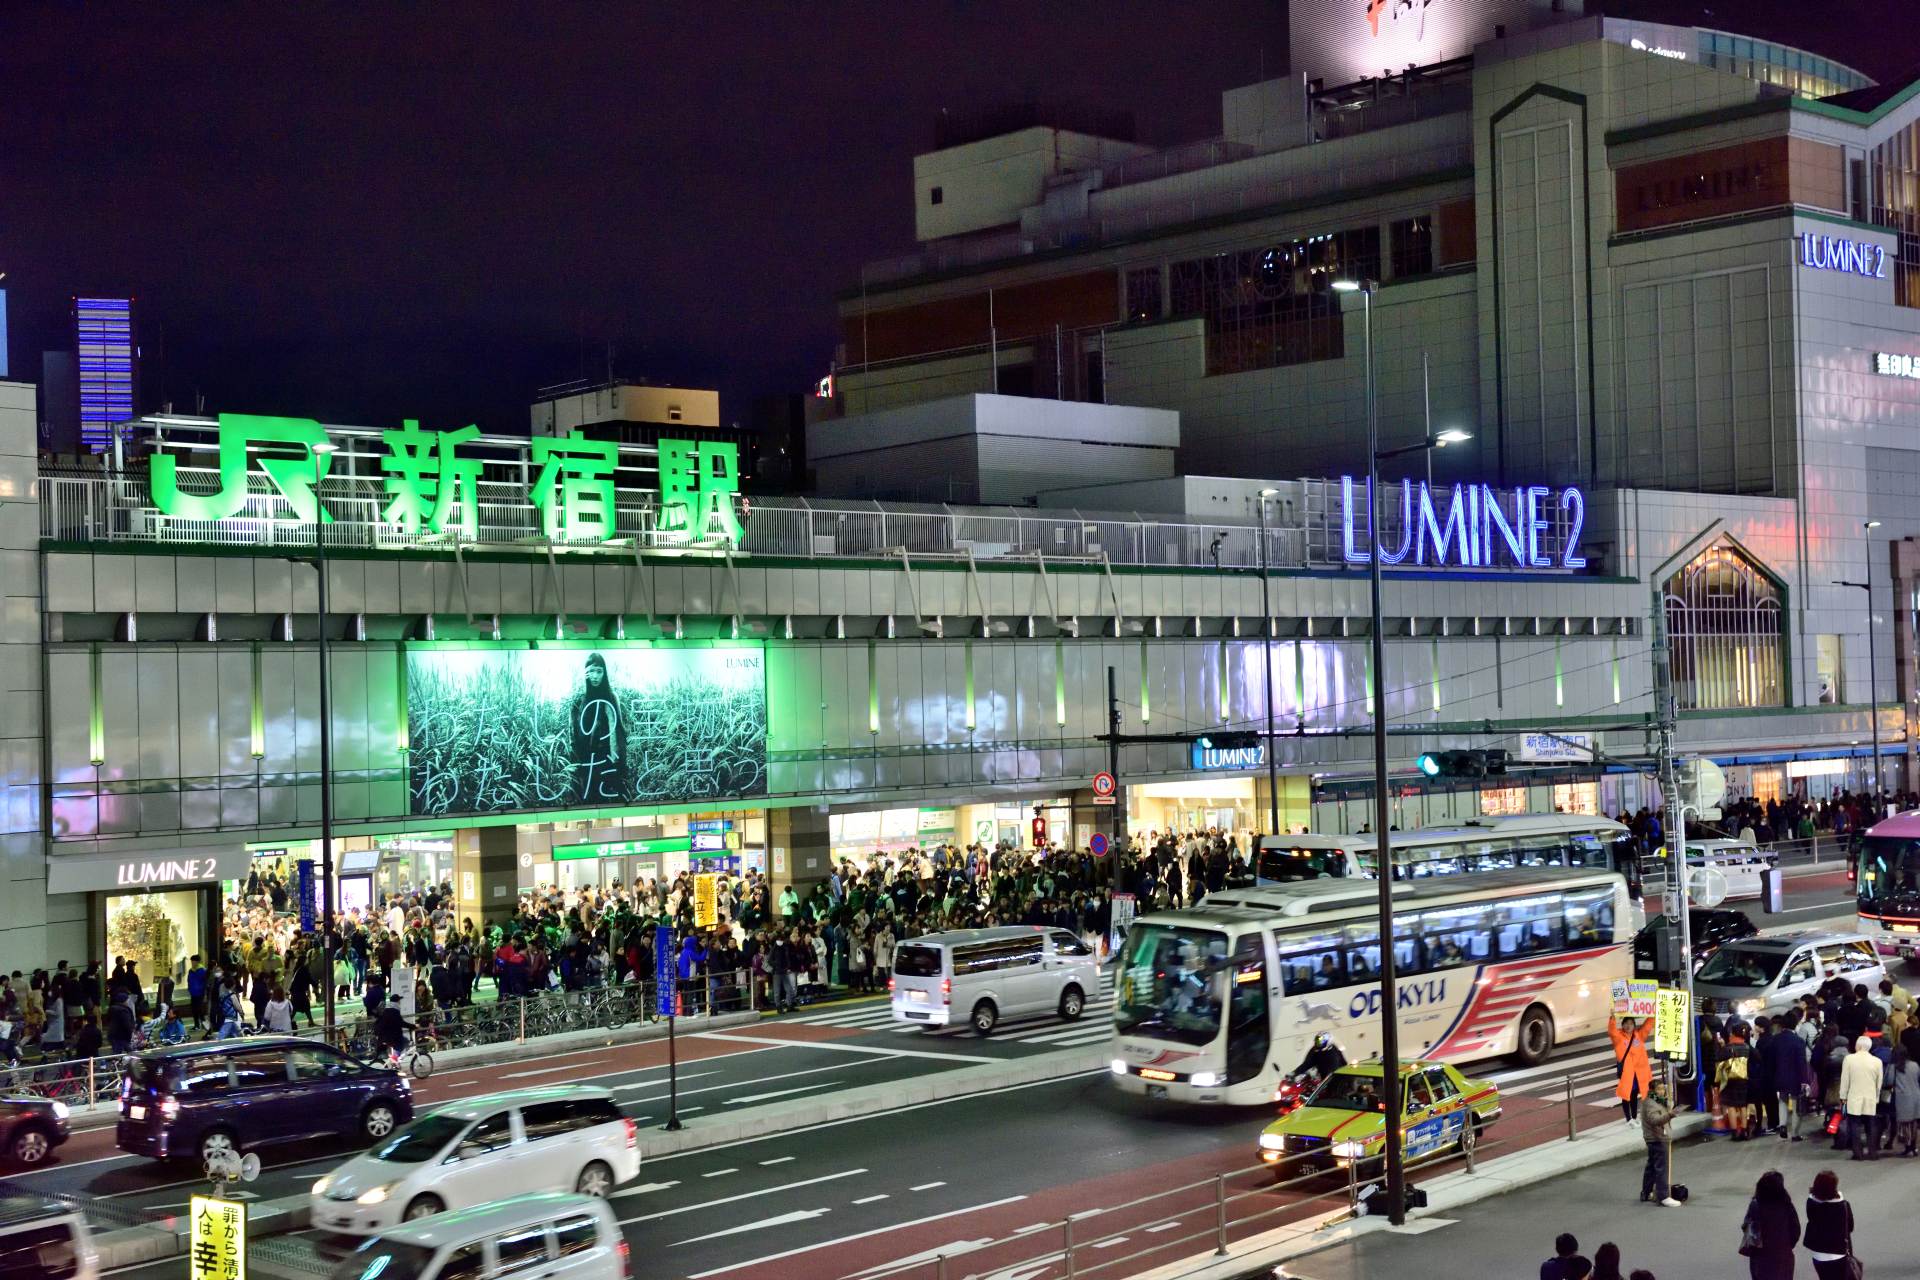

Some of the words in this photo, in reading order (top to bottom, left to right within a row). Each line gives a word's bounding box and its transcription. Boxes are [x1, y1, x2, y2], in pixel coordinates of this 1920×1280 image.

[1802, 232, 1872, 276] LUMINE
[1875, 244, 1886, 278] 2
[1342, 475, 1551, 568] LUMINE
[1562, 487, 1586, 567] 2
[416, 745, 759, 810] わたしだと思う
[1205, 747, 1257, 767] LUMINE
[1258, 746, 1265, 763] 2
[118, 859, 200, 885] LUMINE
[202, 858, 217, 879] 2
[1349, 977, 1447, 1019] ODKYU
